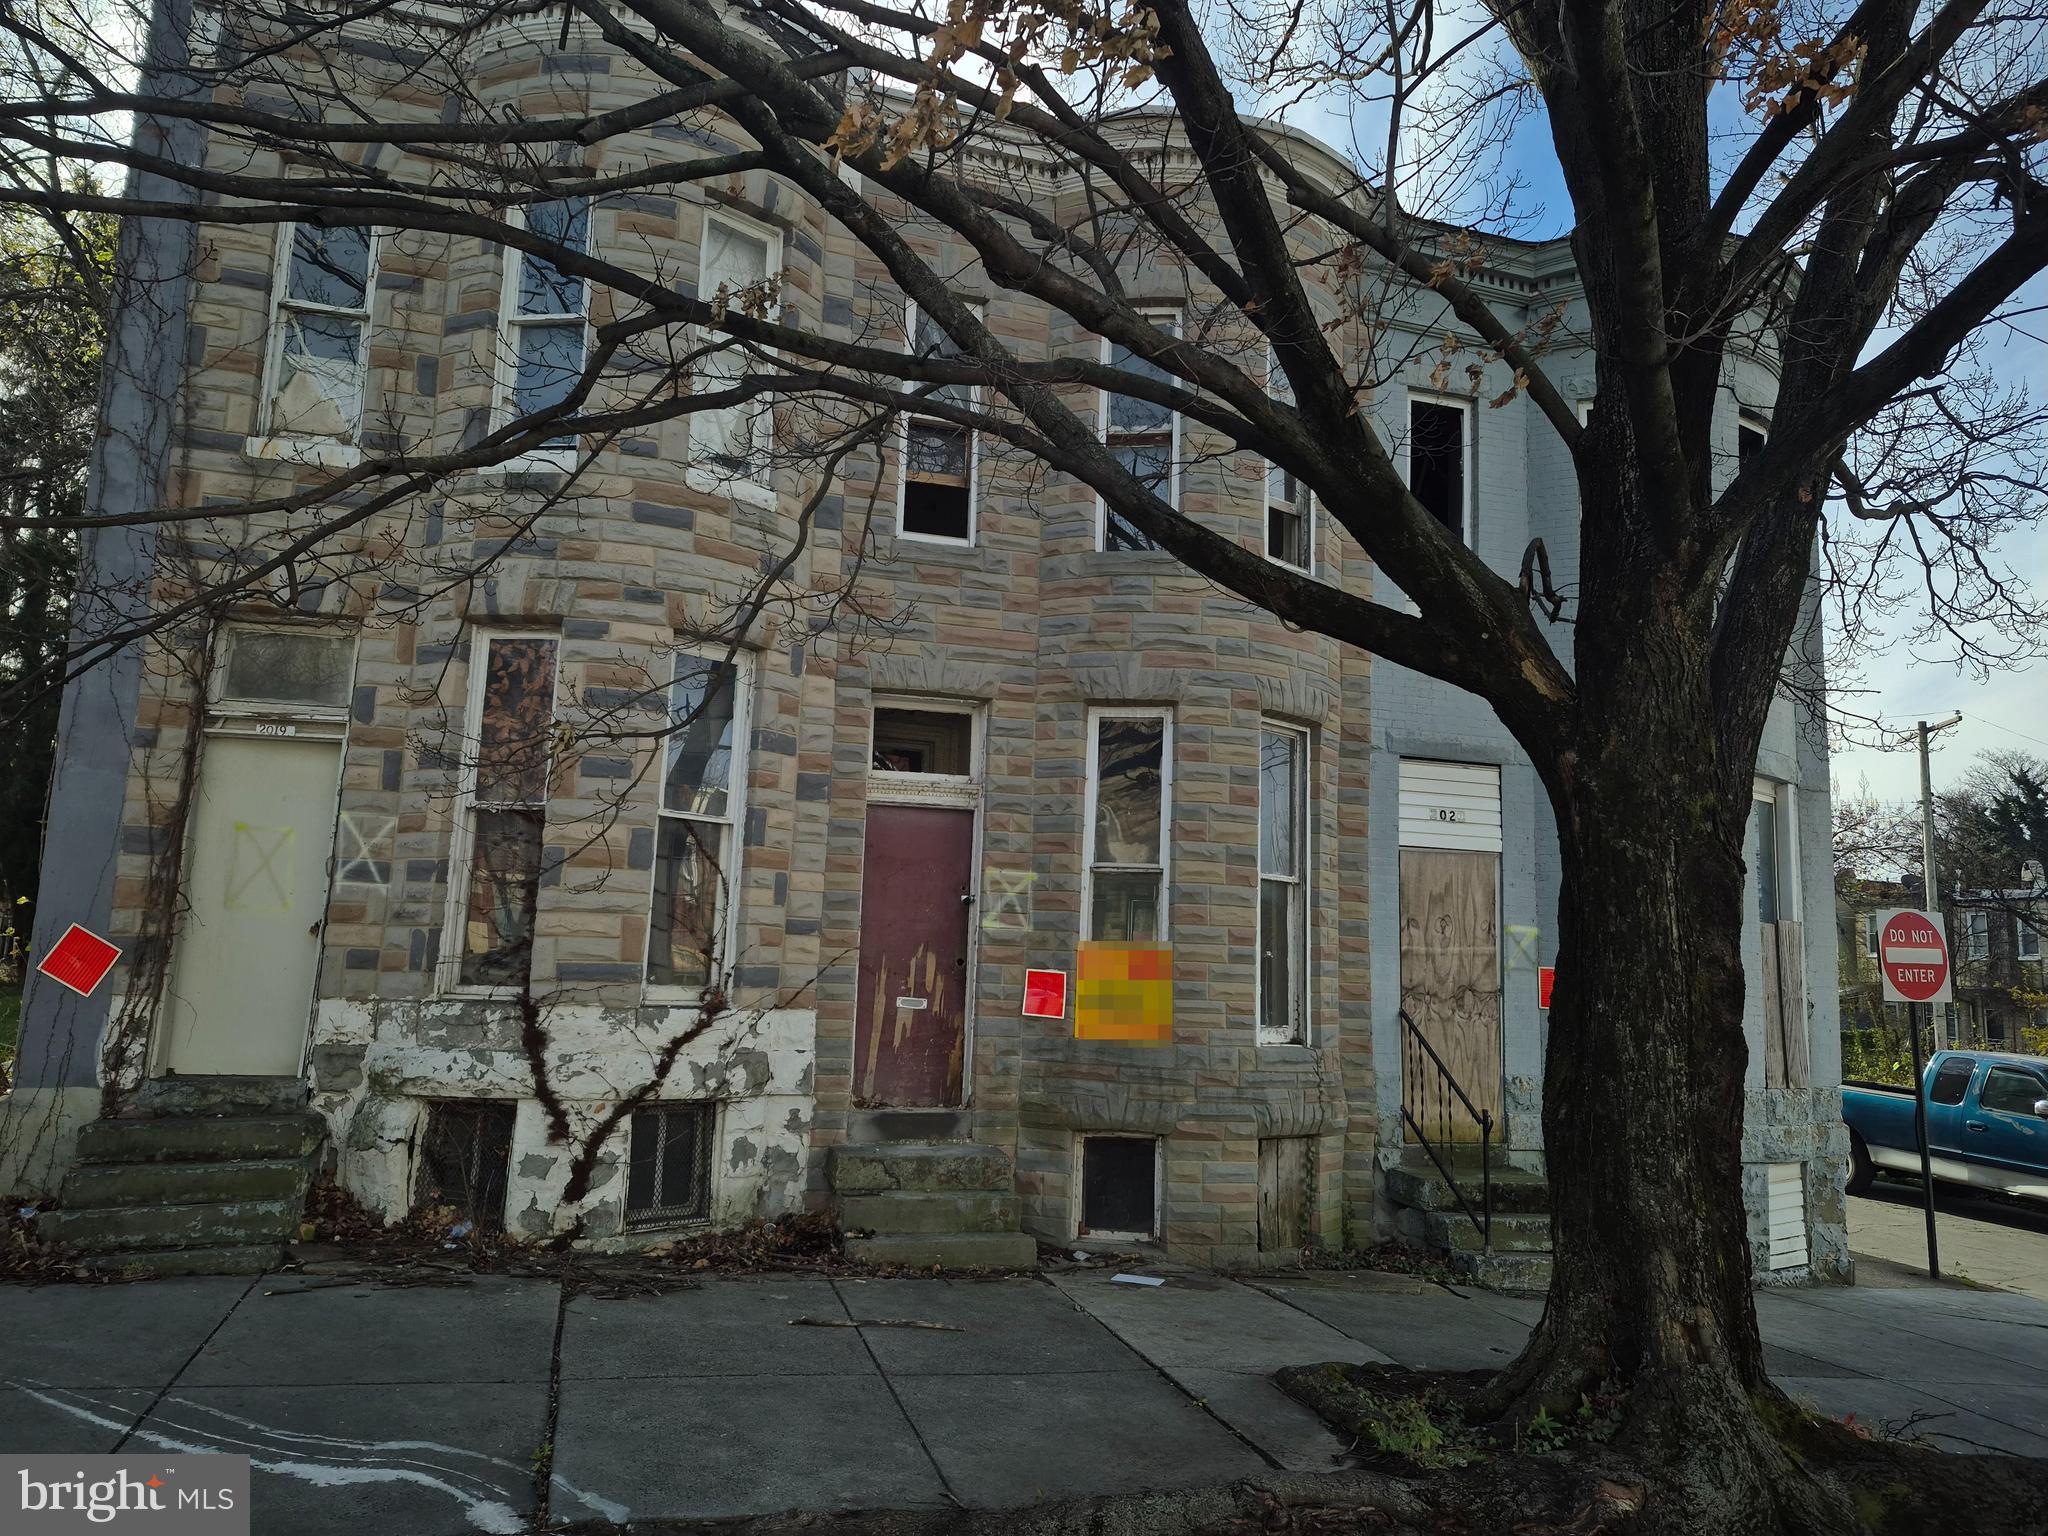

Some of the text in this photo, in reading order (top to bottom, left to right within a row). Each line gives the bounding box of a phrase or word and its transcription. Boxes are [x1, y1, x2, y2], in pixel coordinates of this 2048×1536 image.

[259, 724, 287, 736] 2019
[1889, 928, 1933, 944] DO NOT
[1897, 968, 1936, 983] ENTER
